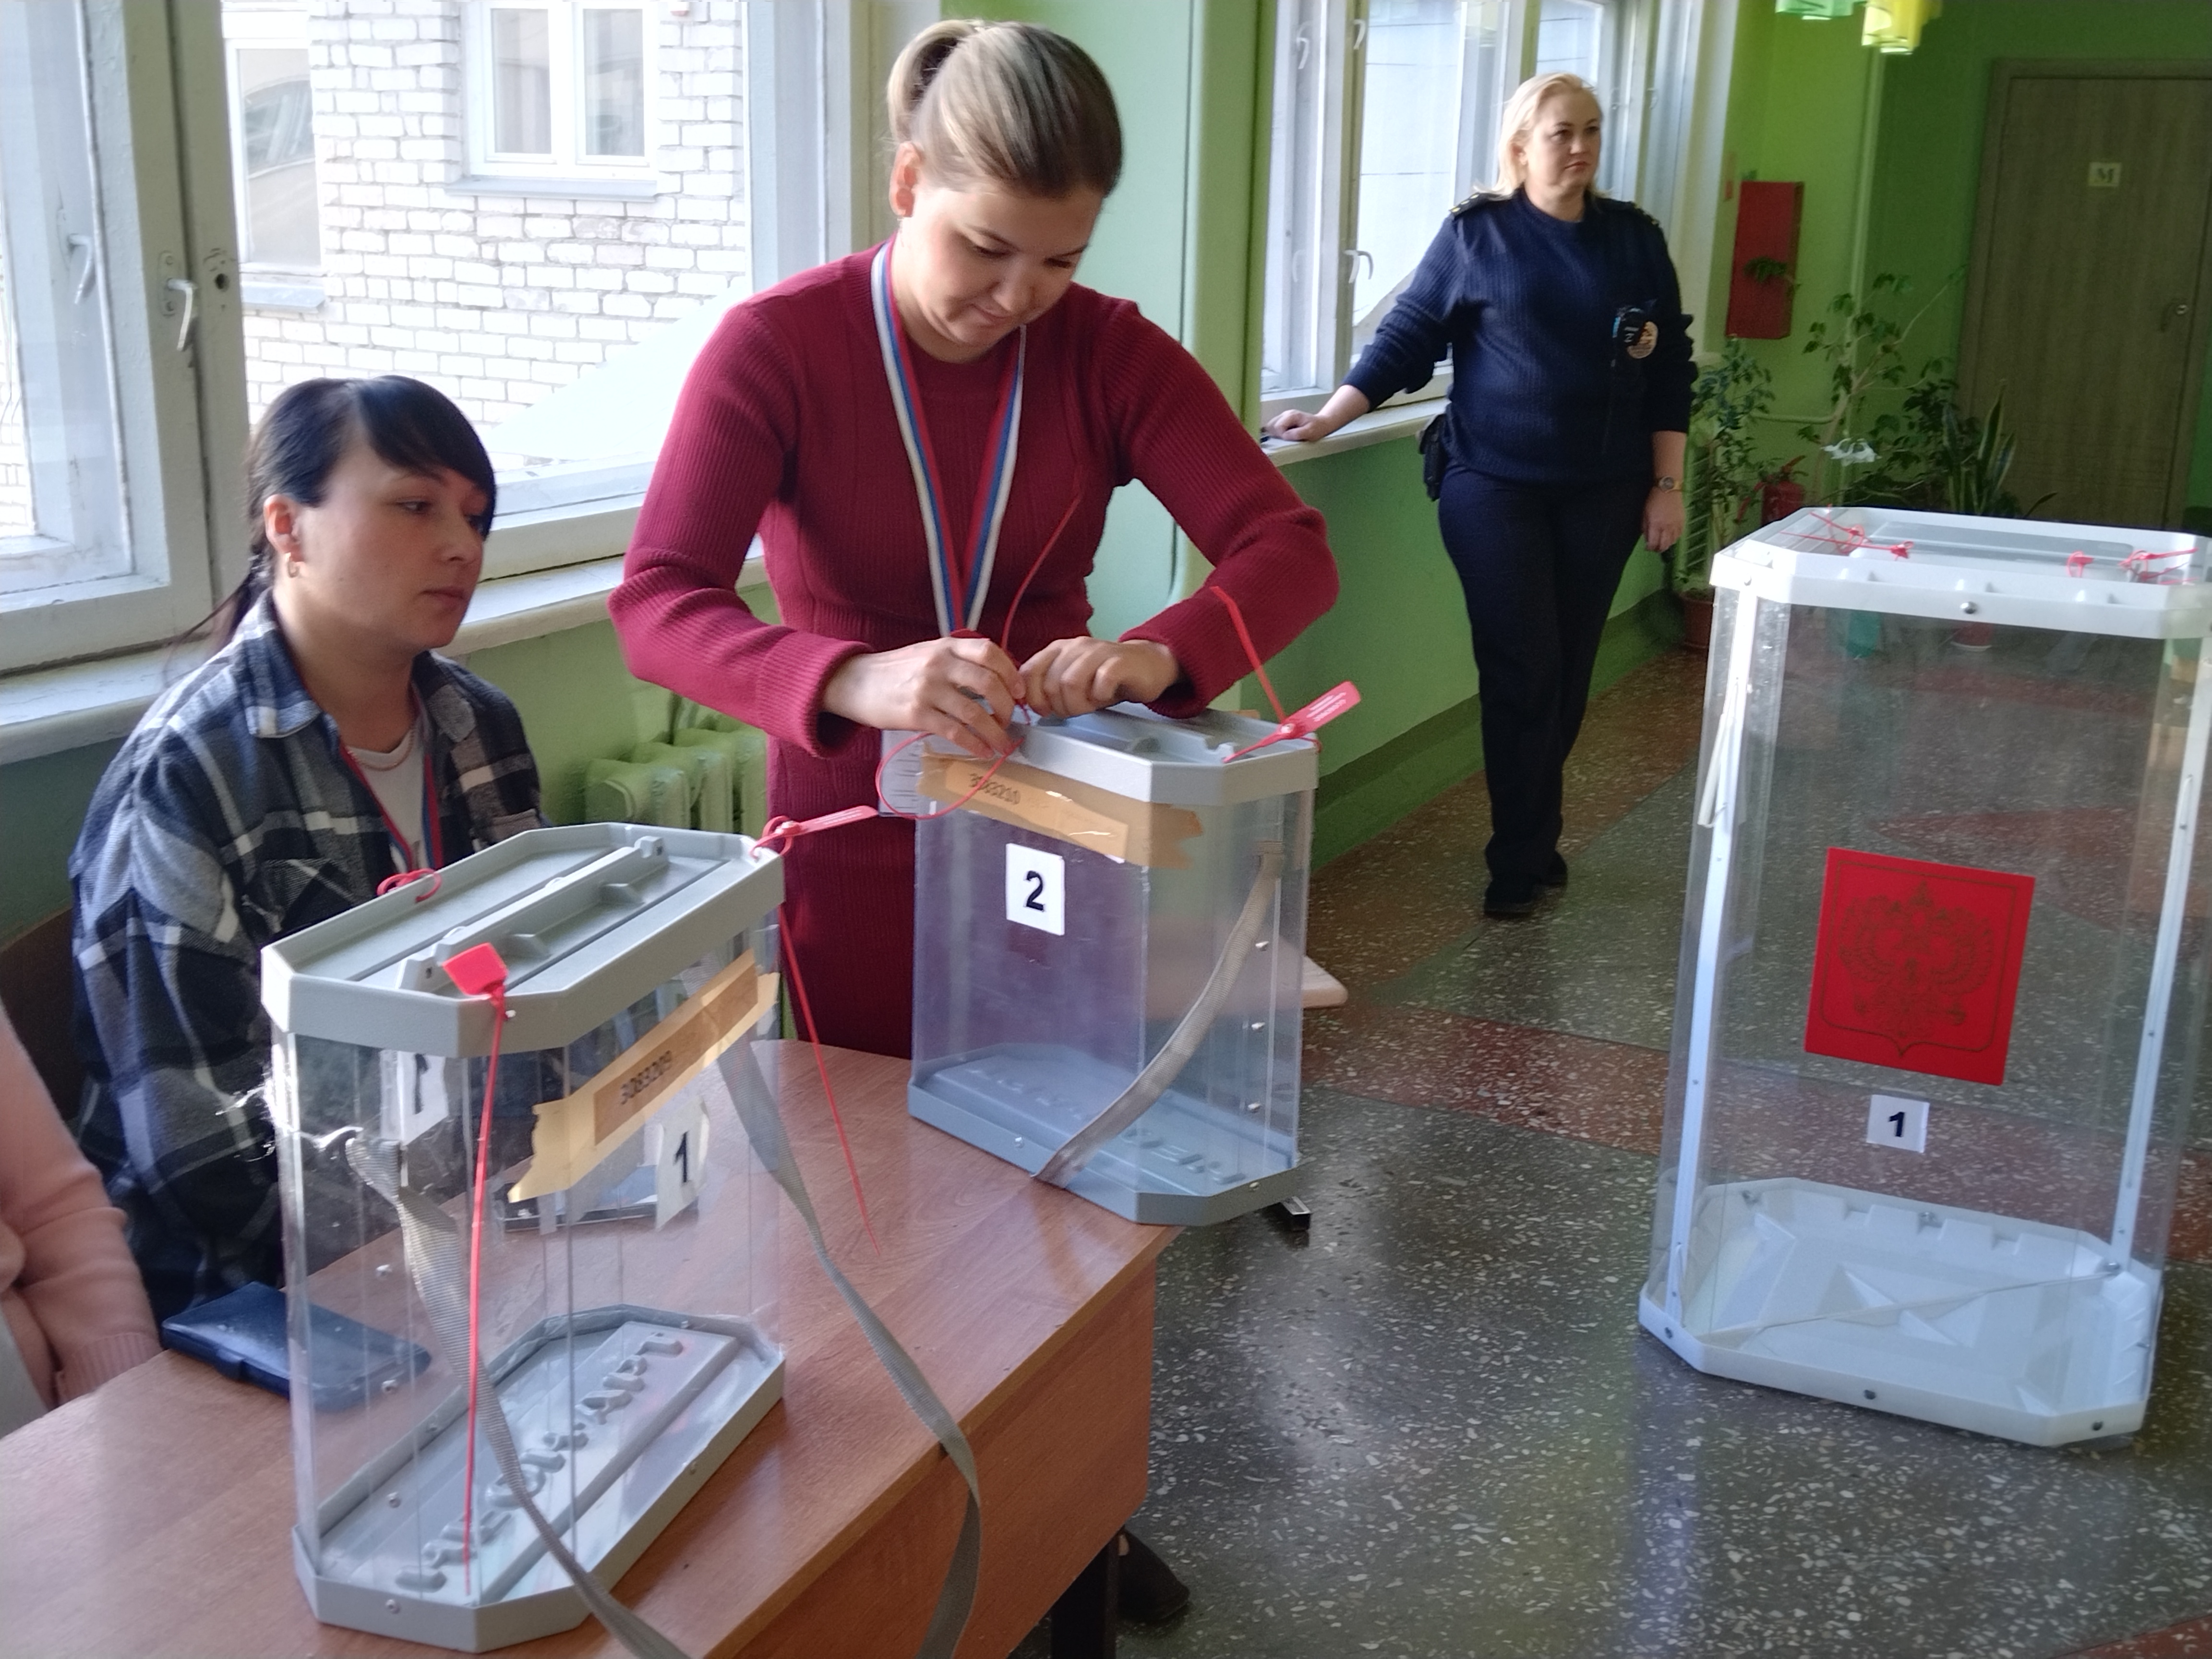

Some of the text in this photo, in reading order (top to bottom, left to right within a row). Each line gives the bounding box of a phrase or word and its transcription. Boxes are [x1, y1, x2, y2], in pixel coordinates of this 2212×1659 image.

[1024, 871, 1046, 912] 2
[1888, 1111, 1906, 1138] 1
[673, 1131, 691, 1184] 1
